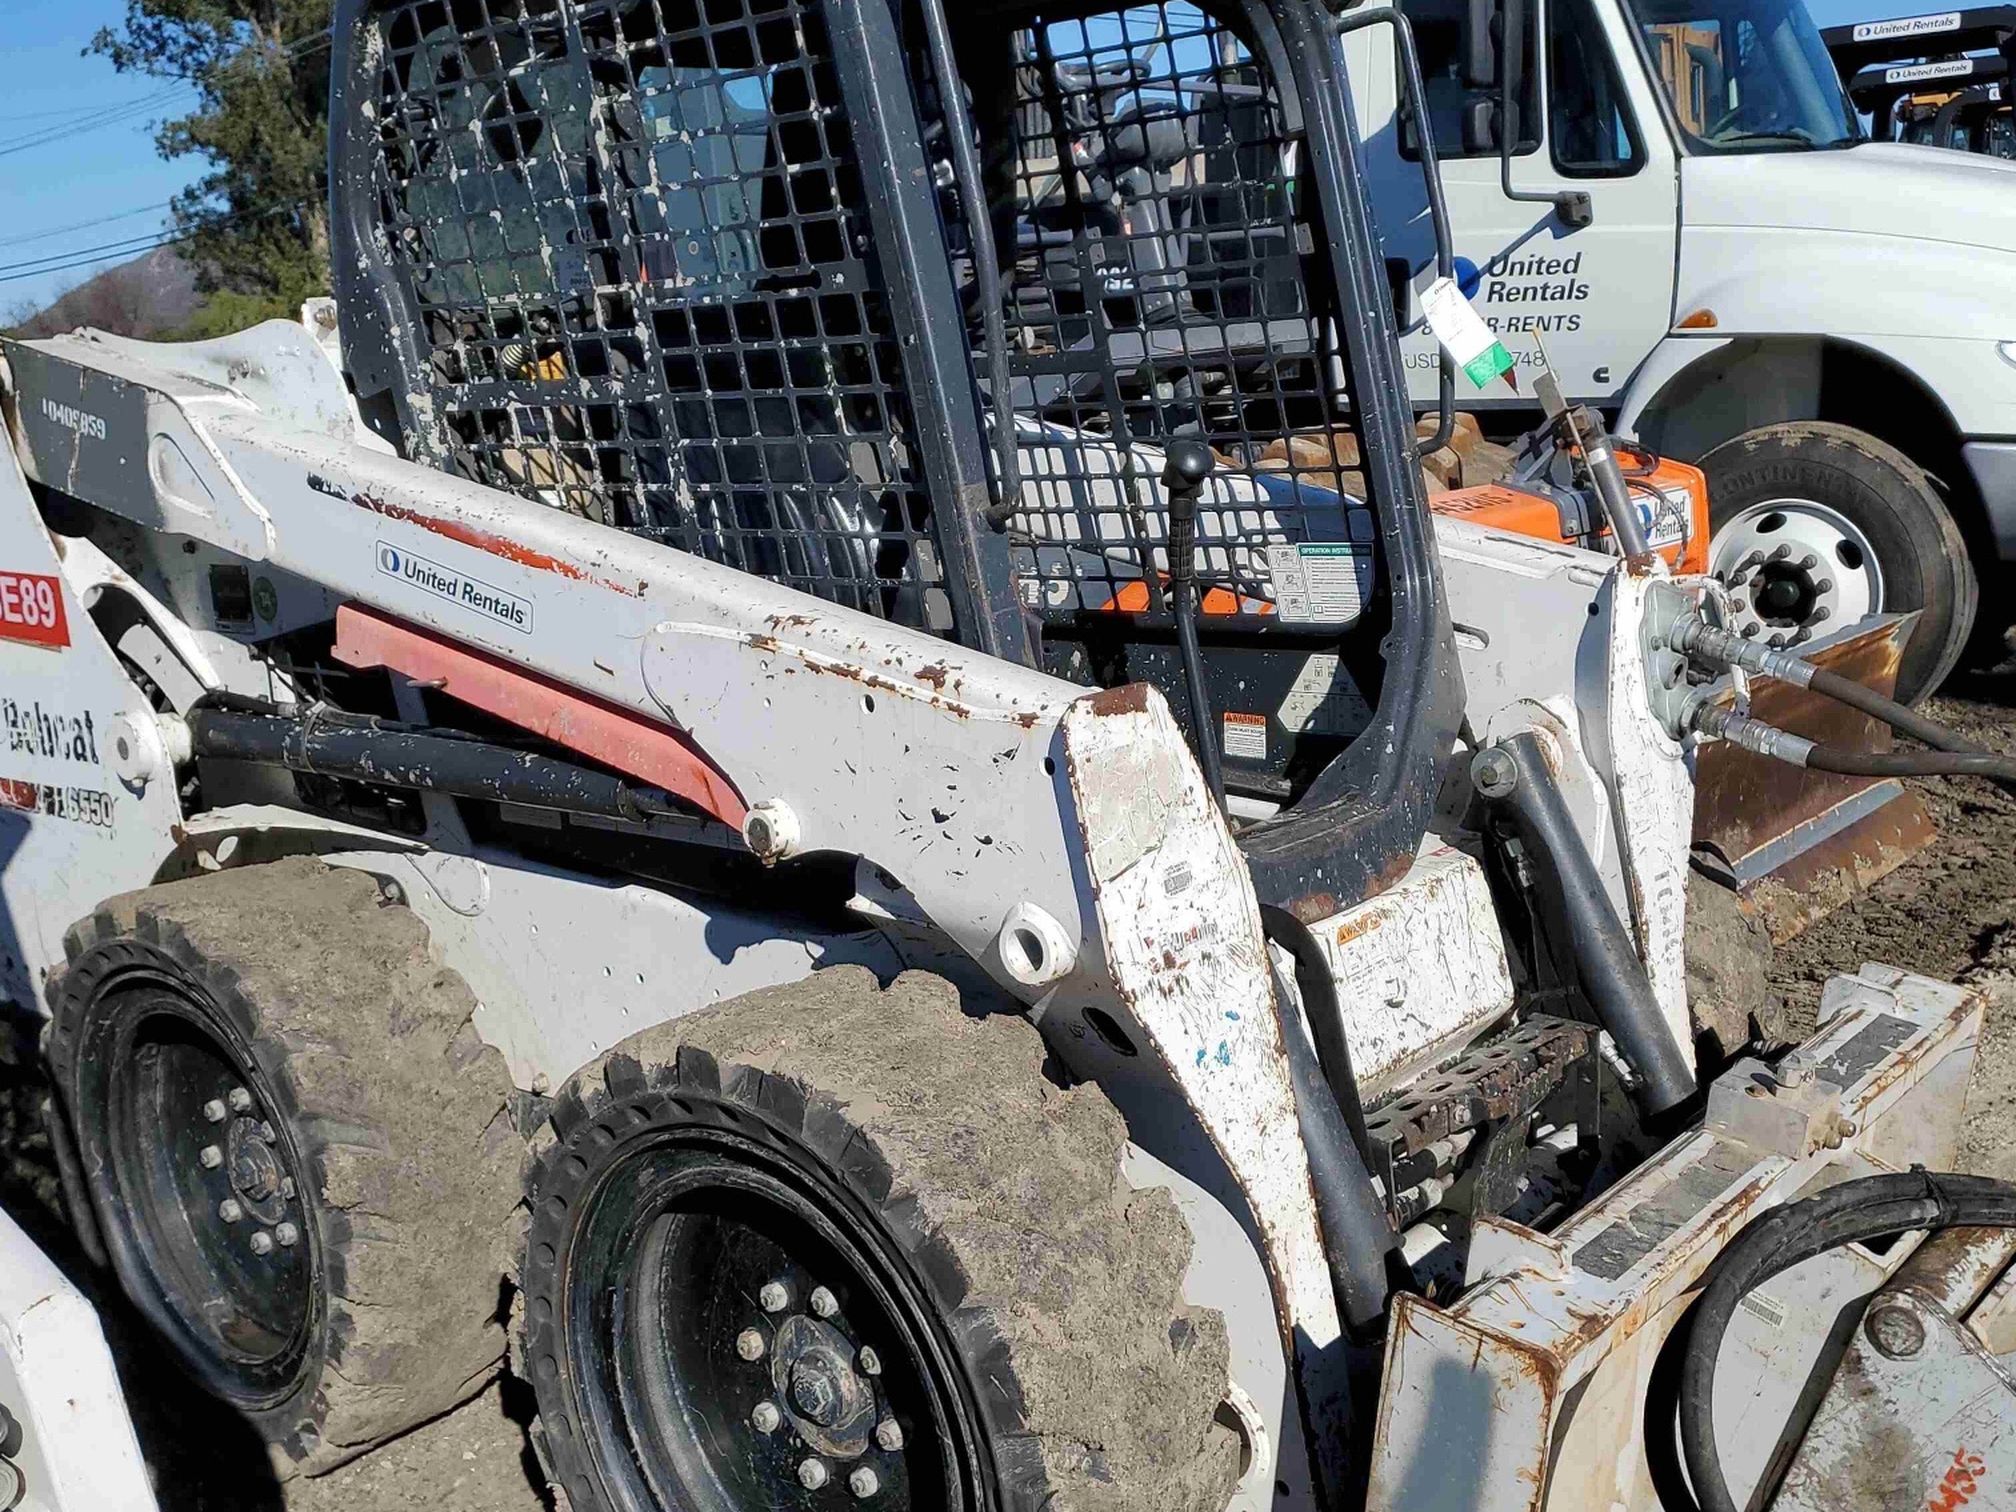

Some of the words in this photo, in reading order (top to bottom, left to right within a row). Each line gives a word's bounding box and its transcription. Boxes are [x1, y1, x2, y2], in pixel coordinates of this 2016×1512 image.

[1874, 22, 1910, 35] United
[1913, 17, 1954, 29] Rentals
[1902, 67, 1933, 78] United
[1934, 64, 1967, 74] Rentals
[1487, 252, 1582, 277] United
[1486, 278, 1590, 303] Rentals
[0, 576, 56, 628] E89
[404, 558, 458, 597] United
[461, 581, 525, 625] Rentals
[1231, 714, 1265, 726] WARNING
